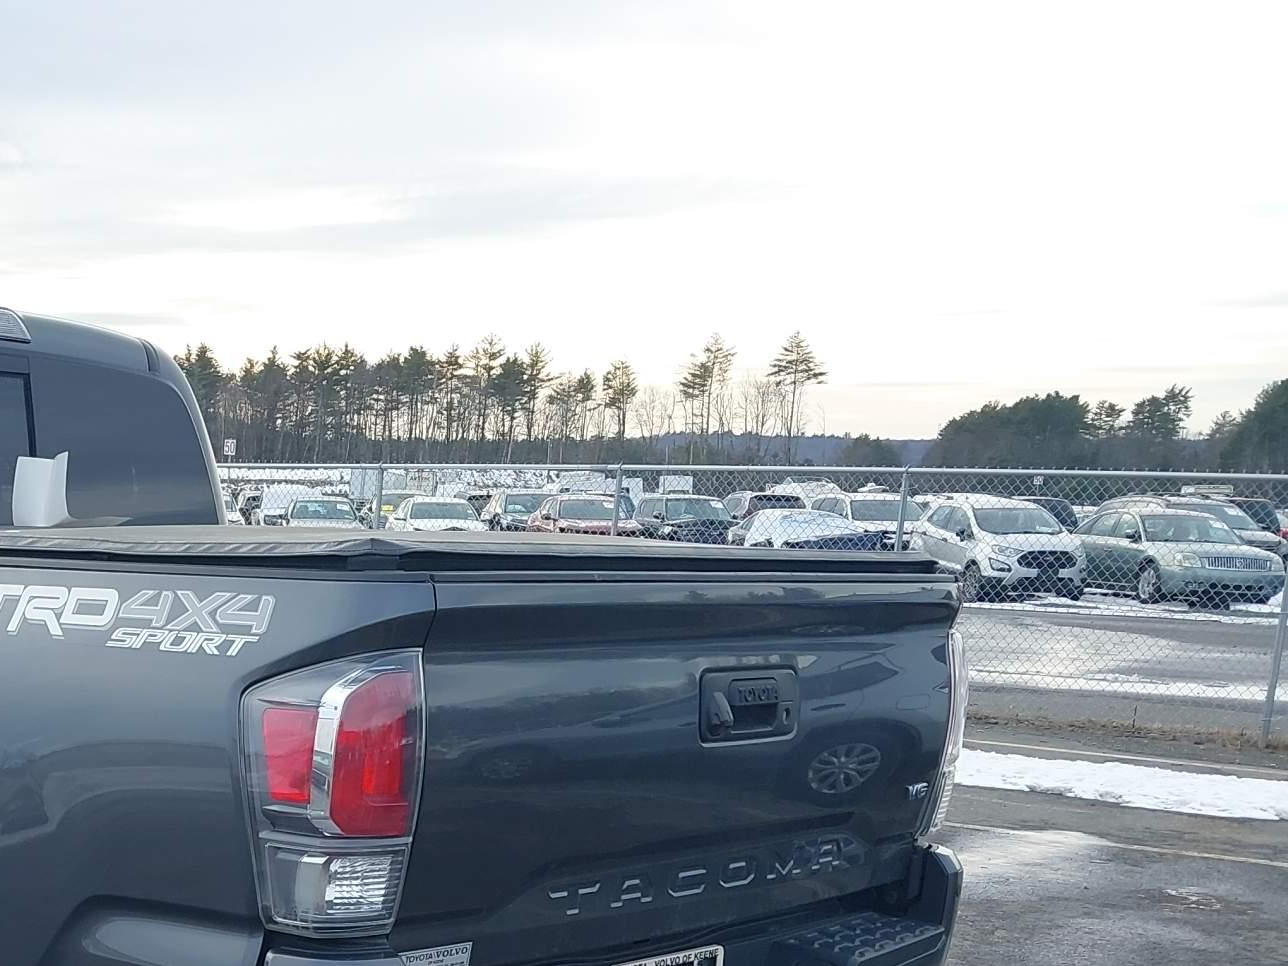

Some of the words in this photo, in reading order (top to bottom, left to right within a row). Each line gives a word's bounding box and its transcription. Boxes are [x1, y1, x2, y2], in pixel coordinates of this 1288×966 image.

[225, 441, 235, 453] 50
[105, 628, 261, 657] SPORT
[737, 685, 778, 702] TOYOTA
[904, 782, 929, 800] V6
[548, 844, 841, 915] TACOMA
[683, 953, 693, 963] OF
[694, 948, 719, 960] KEENE
